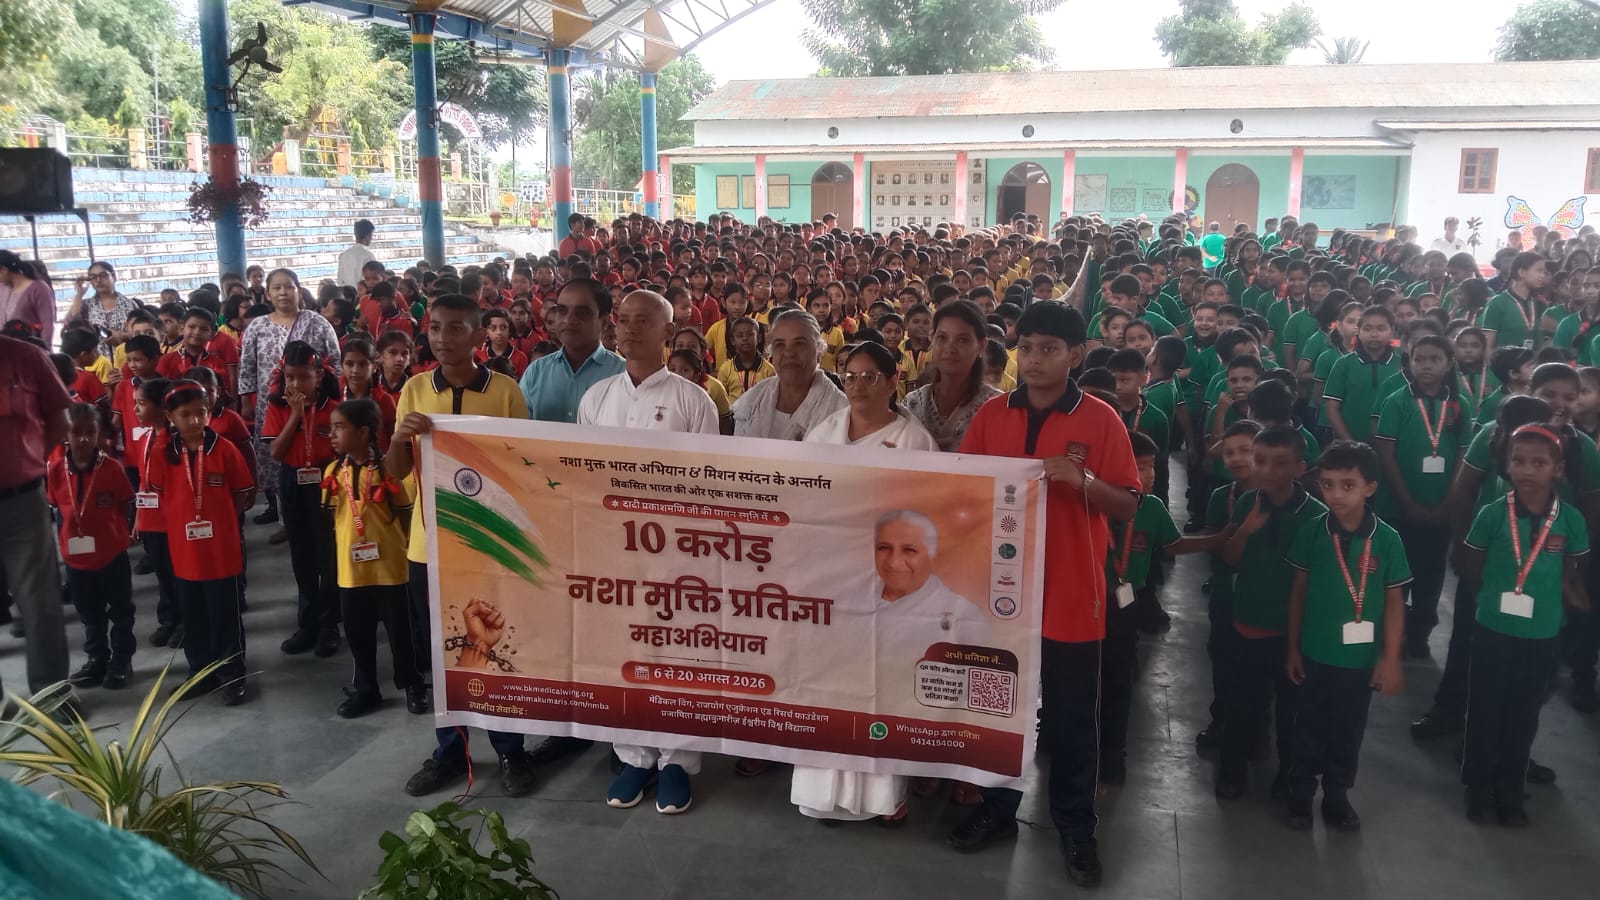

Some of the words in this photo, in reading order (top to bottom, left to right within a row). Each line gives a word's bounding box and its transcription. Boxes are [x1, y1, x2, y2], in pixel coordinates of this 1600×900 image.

[560, 456, 582, 467] नशा
[584, 458, 606, 472] मुक्त
[608, 461, 637, 473] भारत
[640, 461, 686, 477] अभियान
[689, 466, 701, 478] &
[704, 465, 736, 481] मिशन
[738, 470, 771, 484] स्पंदन
[773, 471, 785, 486] के
[787, 475, 832, 489] अन्तर्गत
[610, 478, 647, 491] विकसित
[649, 484, 672, 493] भारत
[673, 484, 686, 495] की
[688, 486, 706, 497] ओर
[707, 488, 724, 499] एक
[725, 490, 753, 501] सशक्त
[755, 493, 778, 502] कदम
[622, 500, 640, 509] दादी
[642, 501, 685, 513] प्रकाशमणि
[687, 505, 698, 515] जी
[700, 505, 712, 515] की
[713, 509, 736, 518] पावन
[738, 511, 759, 521] स्मृति
[761, 511, 769, 521] में
[622, 520, 667, 553] 10
[675, 521, 774, 572] करोड़
[566, 574, 636, 606] नशा
[642, 575, 723, 621] मुक्ति
[728, 583, 834, 625] प्रतिज्ञा
[629, 623, 768, 655] महाअभियान
[654, 668, 661, 679] 6
[664, 667, 674, 680] से
[677, 670, 694, 681] 20
[697, 672, 730, 685] अगस्त
[733, 675, 766, 689] 2026
[488, 692, 610, 710] www.brahmakumaris.com/nmba
[503, 684, 594, 699] www.bkmedicalwing.org
[469, 701, 495, 713] स्थानीय
[649, 694, 676, 706] मेडिकल
[696, 699, 724, 711] राजयोग
[726, 702, 759, 714] एजुकेशन
[773, 707, 793, 719] रिसर्च
[795, 711, 829, 723] फाउंडेशन
[661, 709, 693, 720] प्रजापिता
[767, 719, 783, 732] विश्व
[784, 721, 816, 733] विद्यालय
[896, 723, 939, 737] WhatsApp
